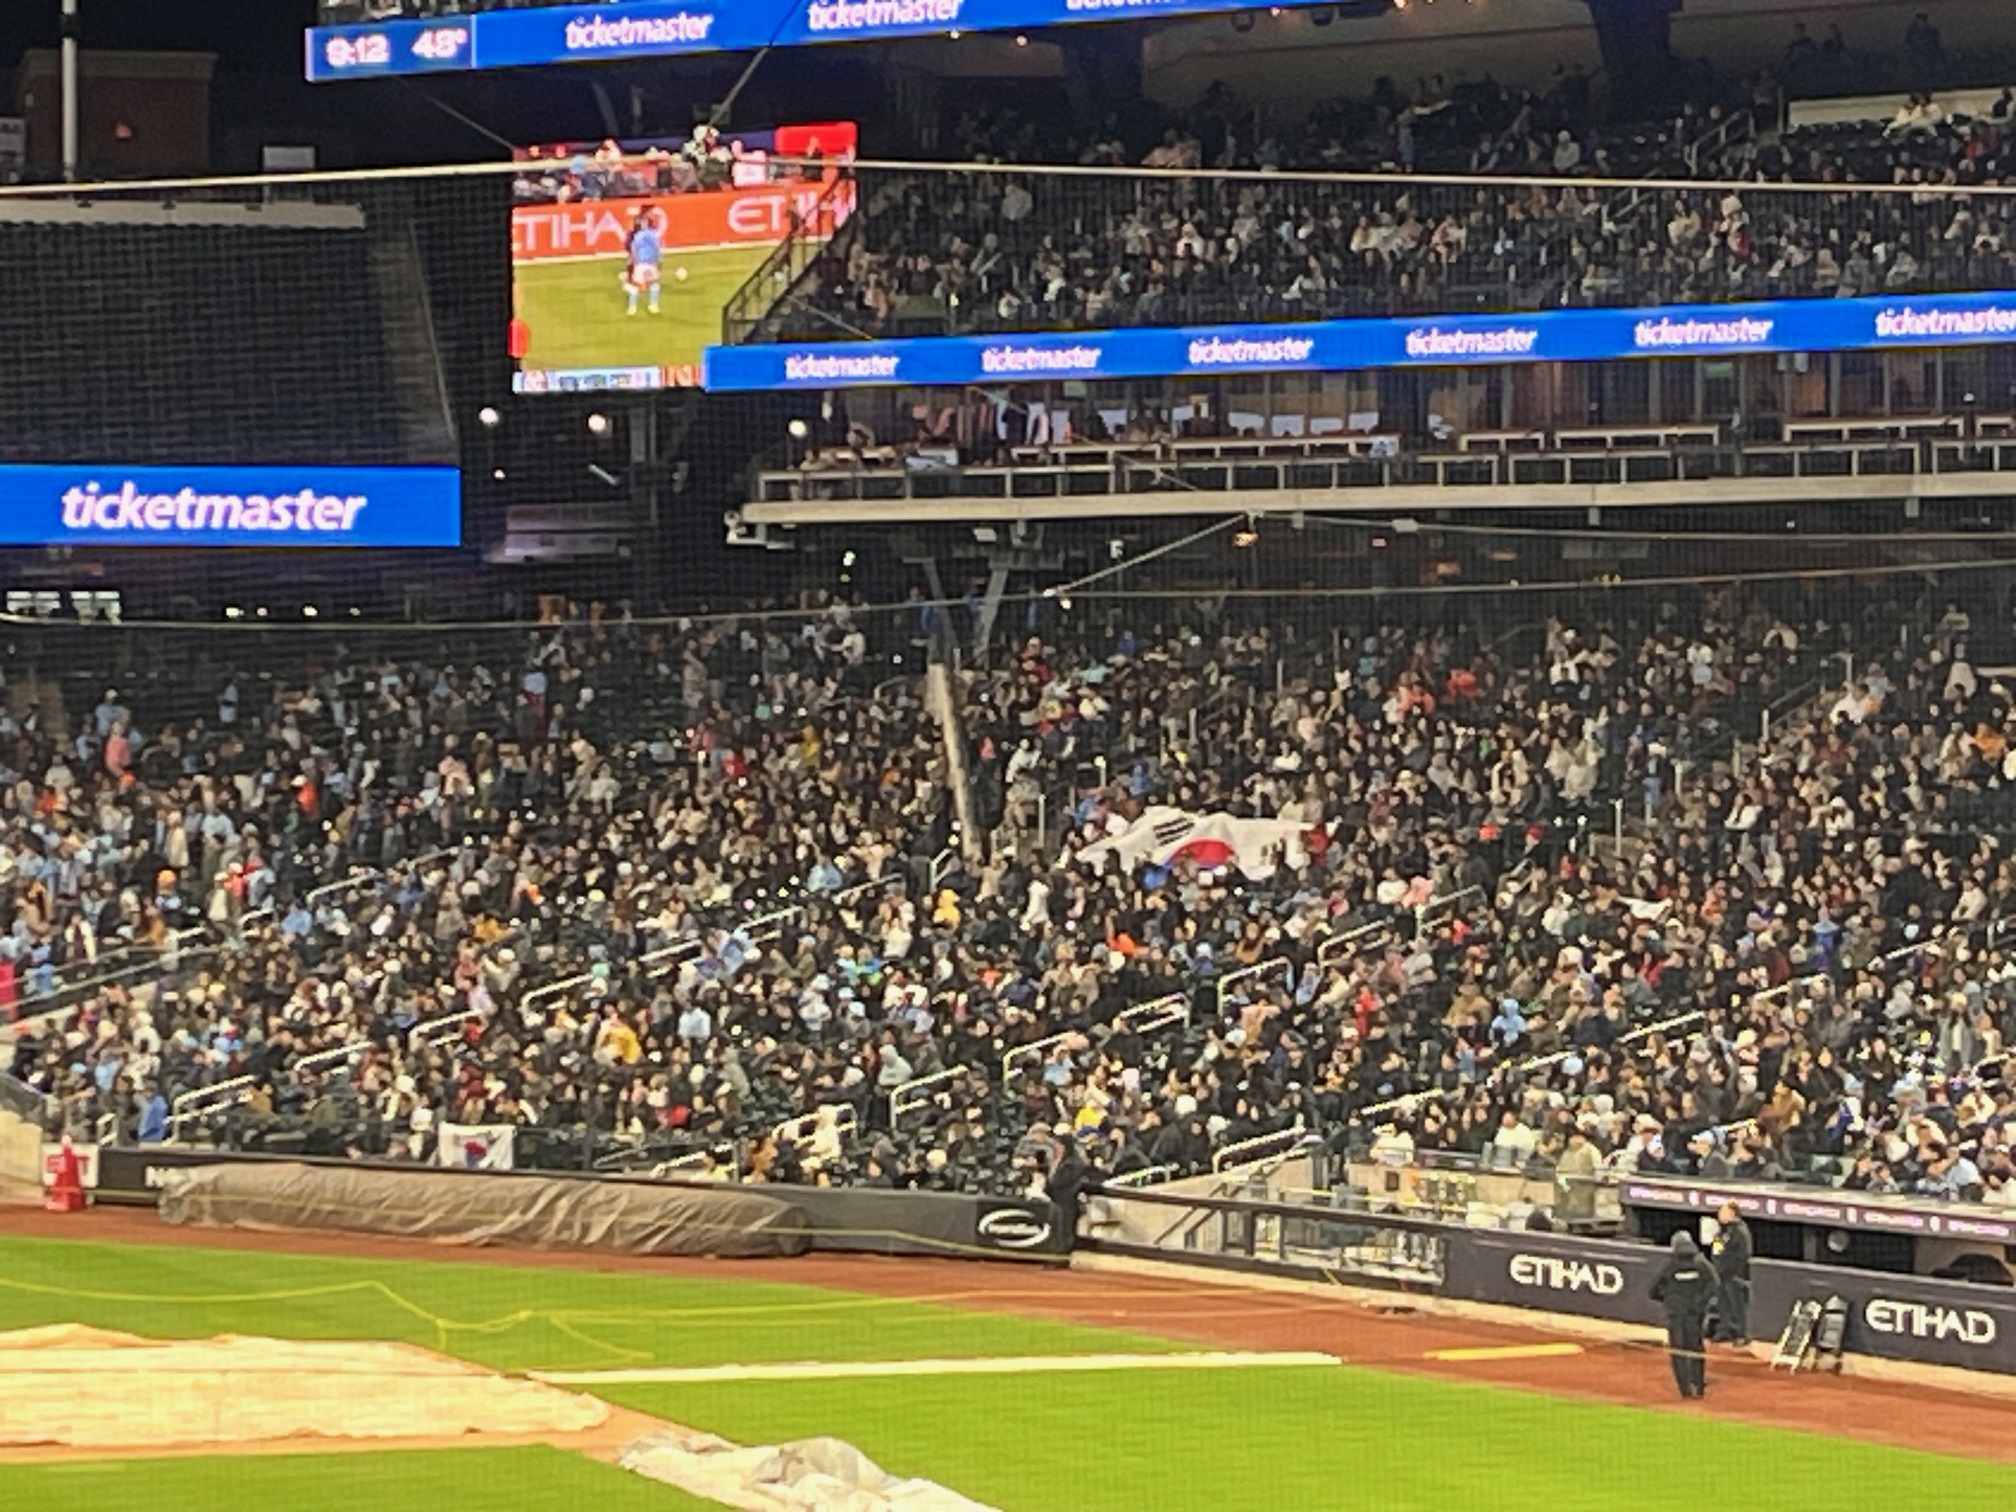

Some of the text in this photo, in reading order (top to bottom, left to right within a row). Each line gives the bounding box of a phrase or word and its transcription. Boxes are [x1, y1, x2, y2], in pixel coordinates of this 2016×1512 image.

[566, 12, 713, 48] ticketmaster
[807, 0, 963, 32] ticketmaster
[1634, 316, 1774, 347] ticketmaster
[1874, 306, 2016, 336] ticketmaster
[1188, 336, 1314, 364] ticketmaster
[1406, 327, 1537, 357] ticketmaster
[785, 353, 899, 379] ticketmaster
[981, 345, 1102, 373] ticketmaster
[61, 481, 368, 530] ticketmaster
[1509, 1254, 1624, 1294] ETIHAD
[1865, 1299, 1996, 1344] ETIHAD
